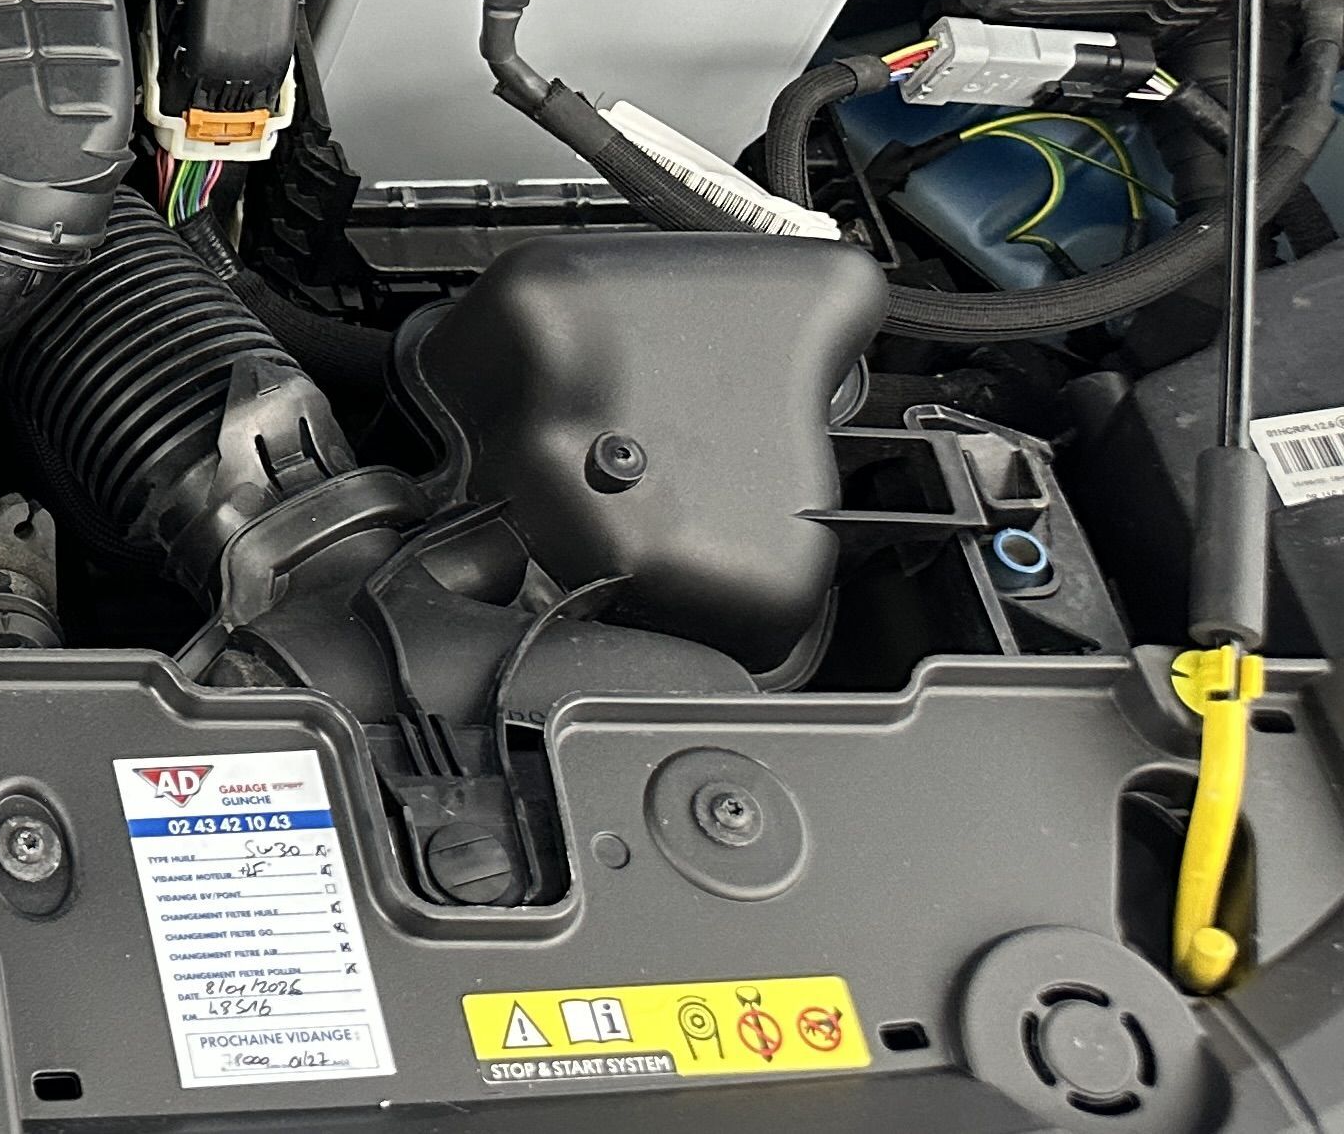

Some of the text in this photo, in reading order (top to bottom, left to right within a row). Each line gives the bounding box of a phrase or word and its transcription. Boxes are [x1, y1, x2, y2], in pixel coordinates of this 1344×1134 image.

[155, 770, 199, 798] AD
[219, 783, 267, 794] GARAGE
[168, 815, 291, 835] 02 43 42 10 43
[148, 855, 196, 864] TYPE HUILE
[152, 873, 232, 883] VIDANGE MOTEUR
[157, 893, 197, 902] VIDANGE
[161, 911, 223, 922] CHANGEMENT
[225, 910, 252, 918] FILTRE
[165, 932, 227, 941] CHANGEMENT
[230, 930, 256, 938] FILTRE
[169, 951, 231, 961] CHANGEMENT
[234, 949, 260, 958] FILTRE
[174, 970, 236, 981] CHANGEMENT
[239, 969, 265, 977] FILTRE
[178, 993, 199, 1001] DATE
[200, 1030, 283, 1049] PROCHAINE
[285, 1029, 352, 1043] VIDANGE
[490, 1055, 670, 1079] STOP & START SYSTEM
